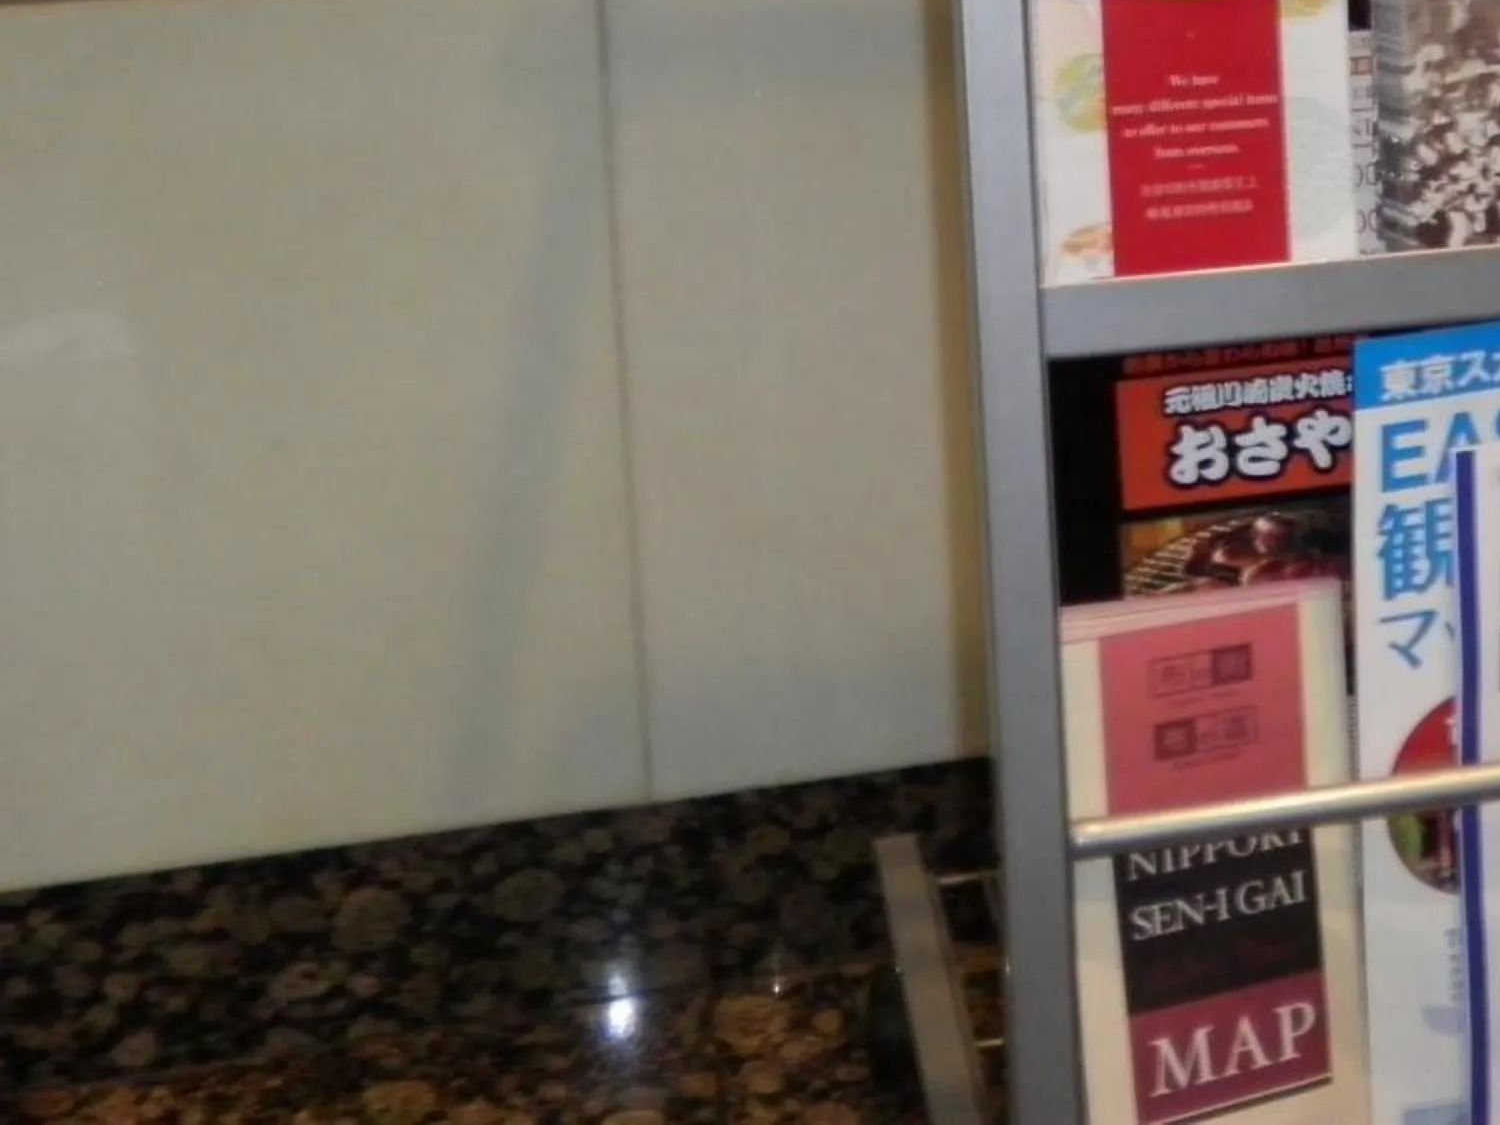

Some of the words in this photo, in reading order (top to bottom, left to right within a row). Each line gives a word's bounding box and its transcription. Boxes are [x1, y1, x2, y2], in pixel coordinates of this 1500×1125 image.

[1169, 409, 1352, 485] おさや
[1147, 1001, 1317, 1098] MAP
